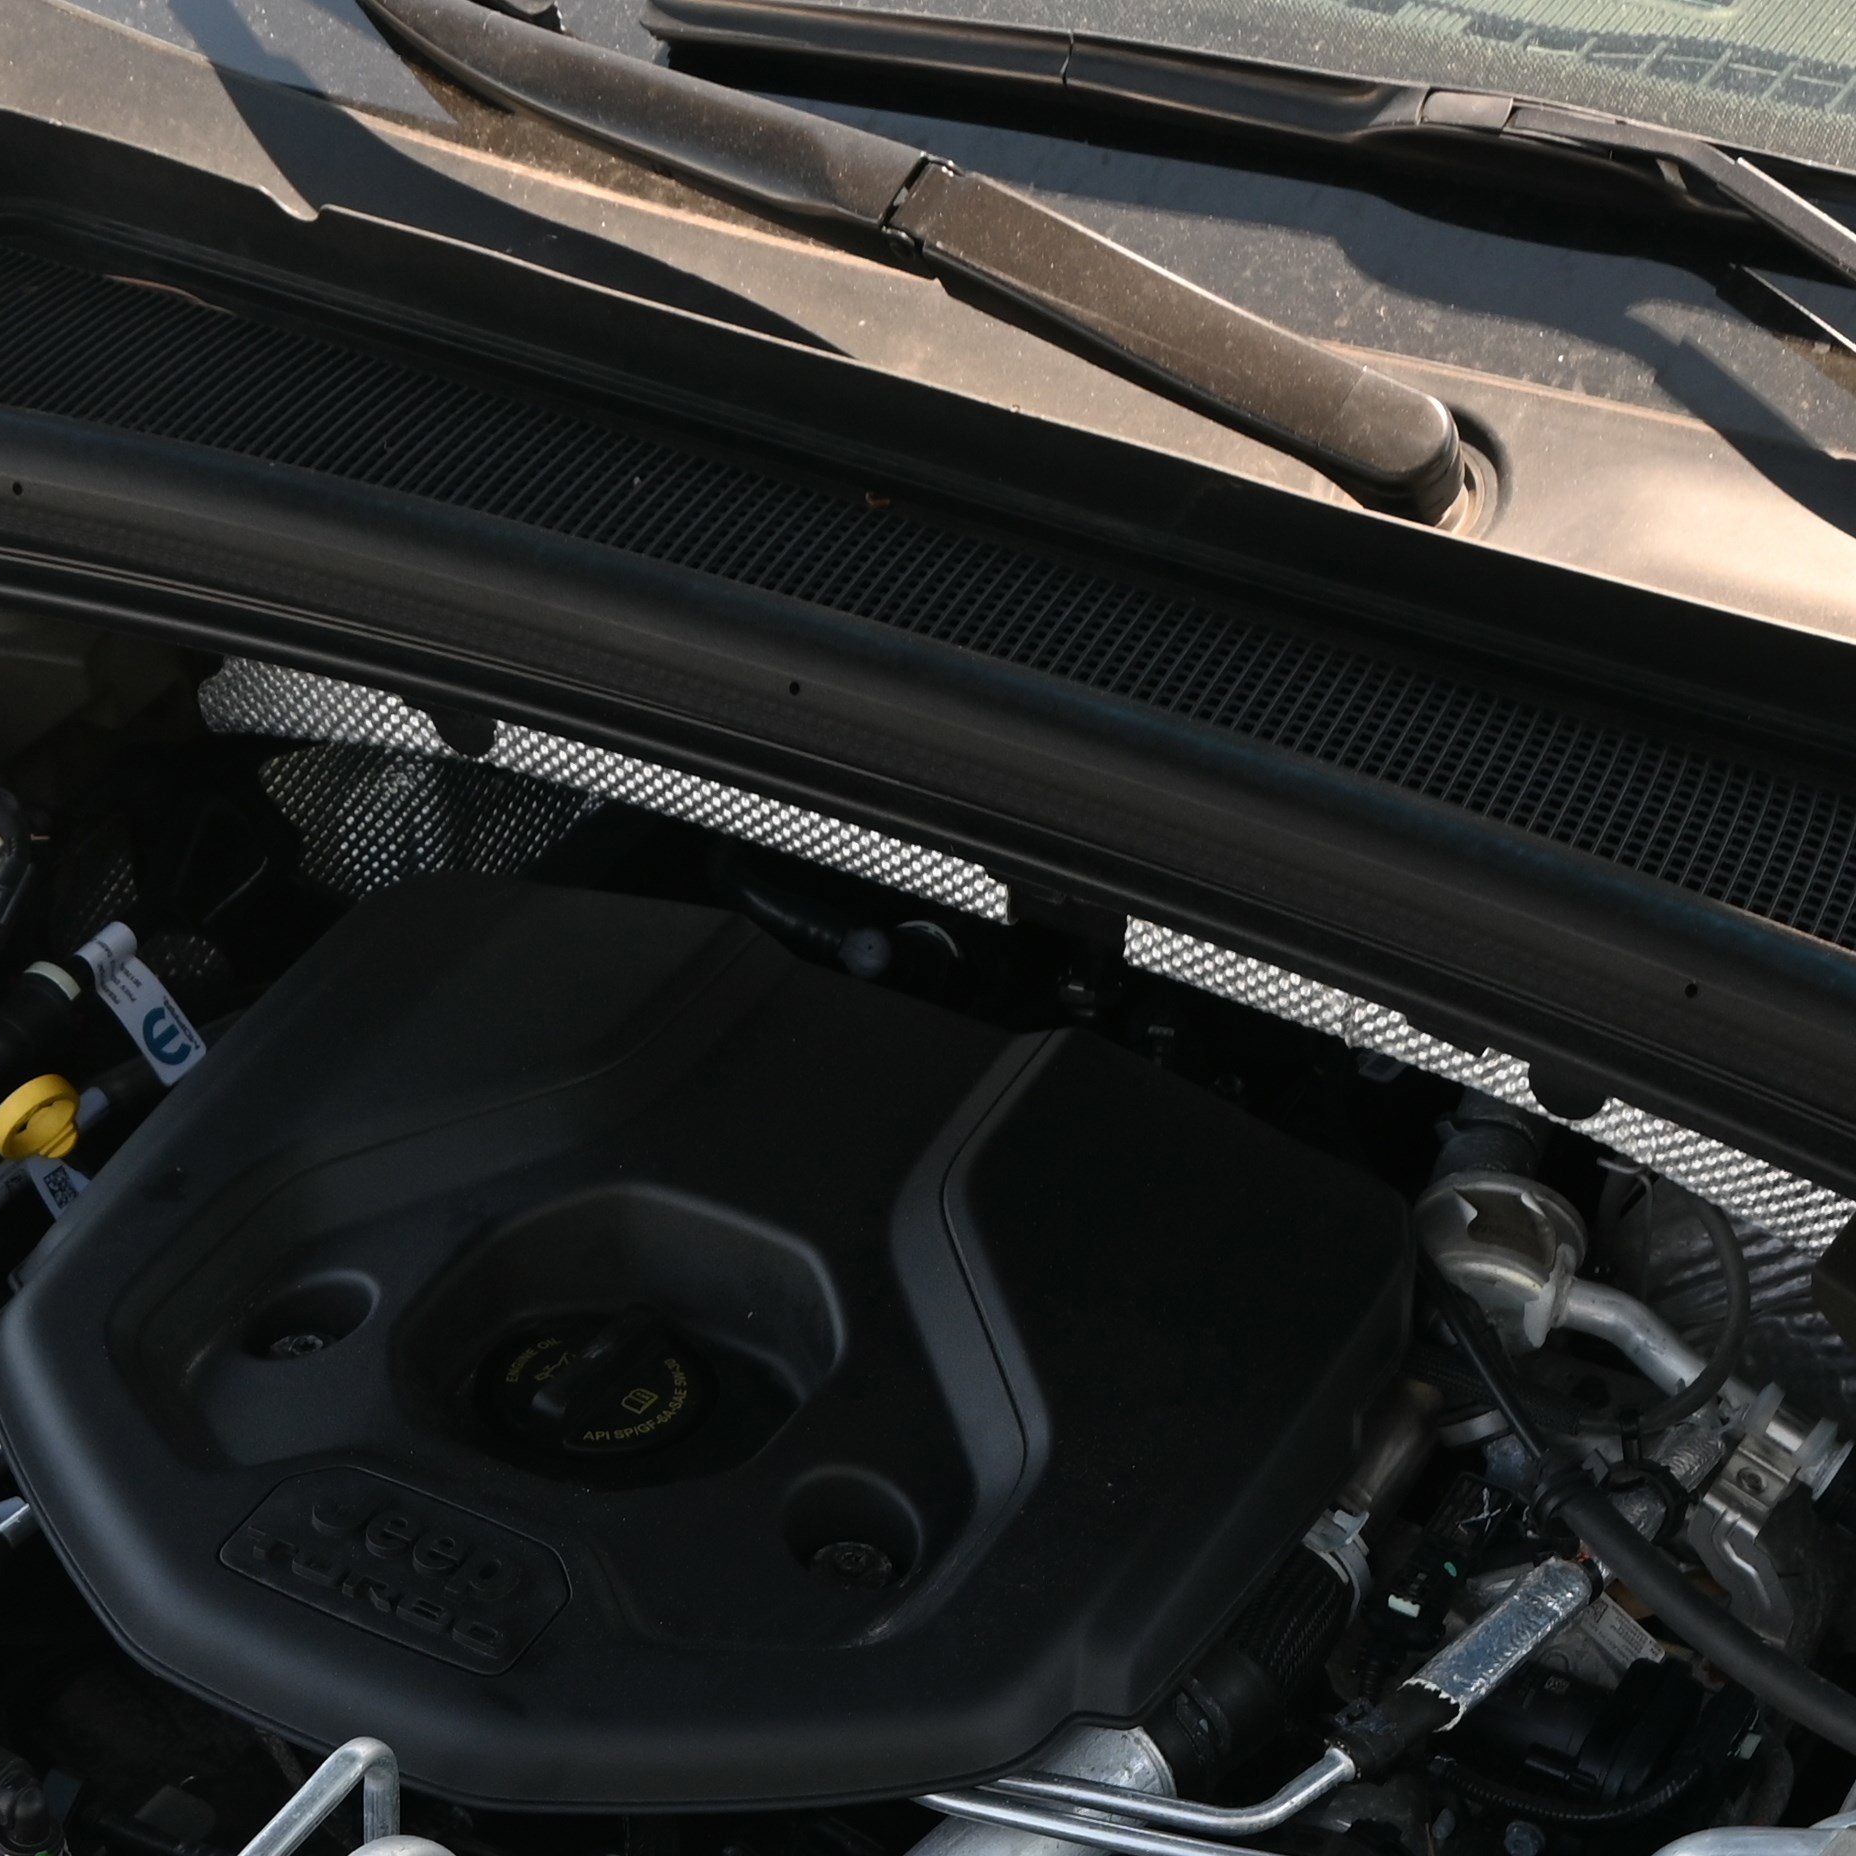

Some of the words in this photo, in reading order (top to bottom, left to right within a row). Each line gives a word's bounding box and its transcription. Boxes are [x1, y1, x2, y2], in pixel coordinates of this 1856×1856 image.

[505, 1347, 539, 1384] ENGINE
[536, 1336, 562, 1351] OIL
[582, 1430, 611, 1442] API
[311, 1488, 526, 1602] Jeep
[246, 1524, 511, 1660] TURBO
